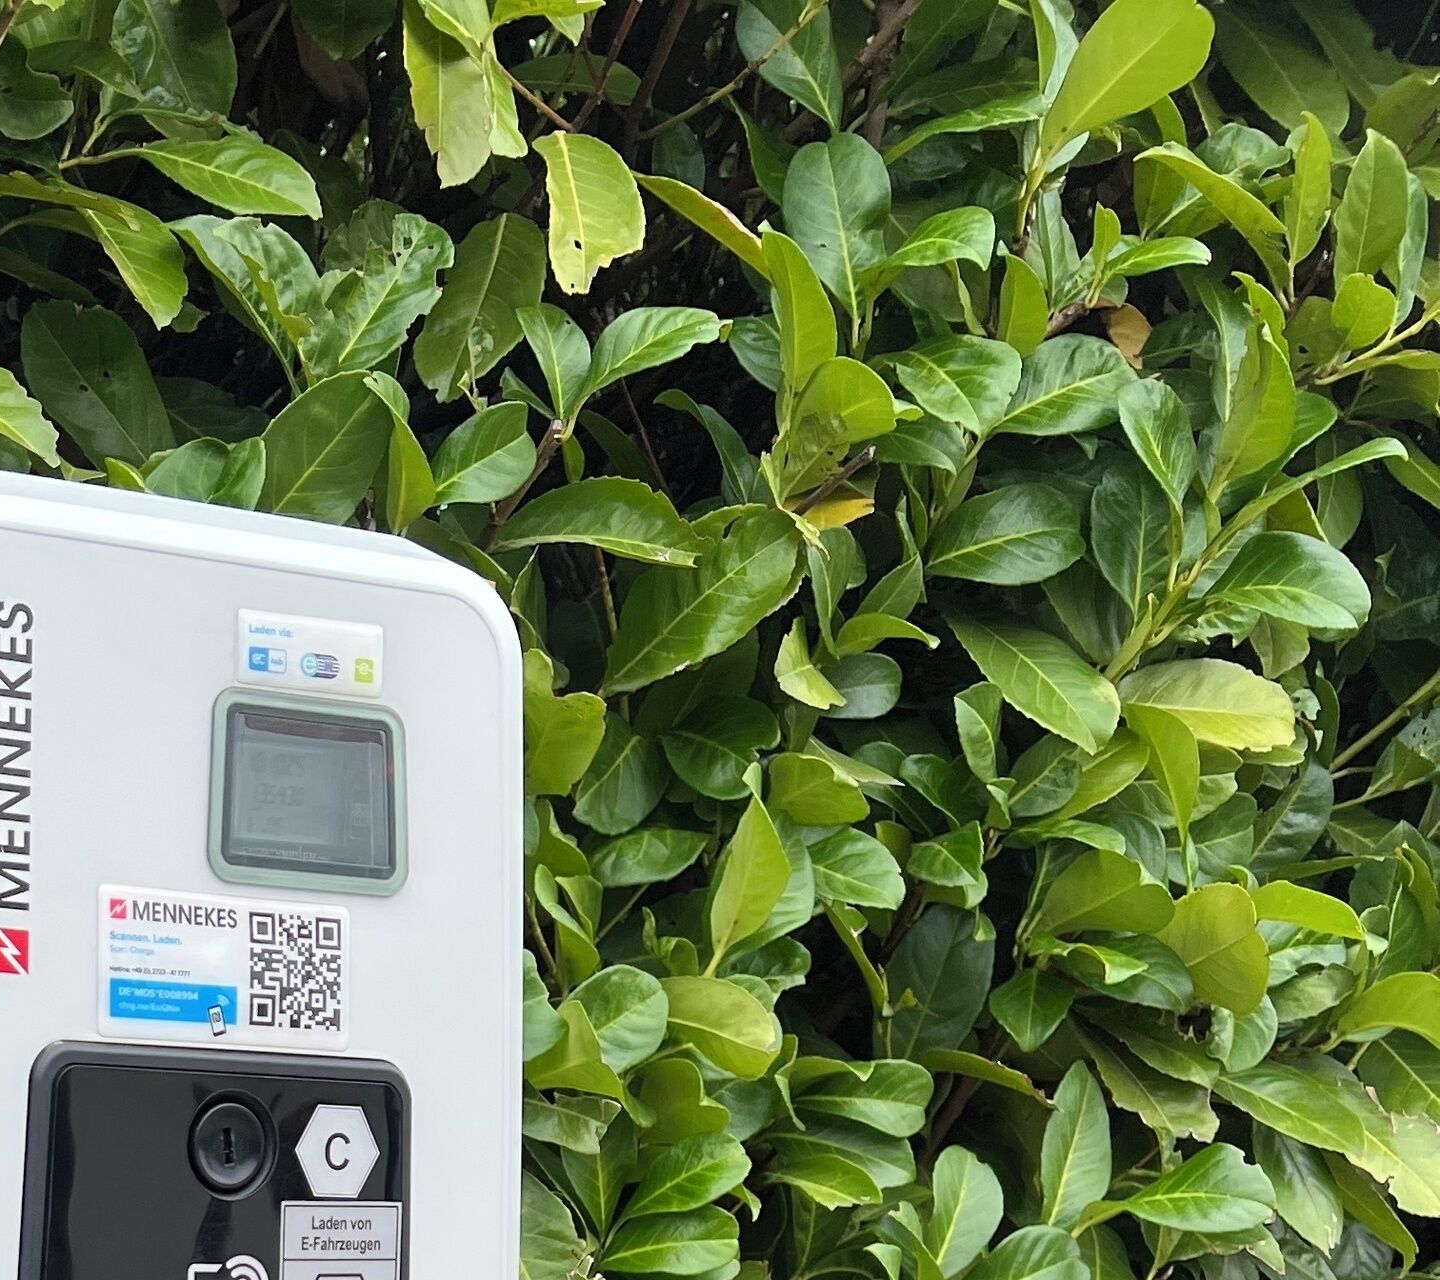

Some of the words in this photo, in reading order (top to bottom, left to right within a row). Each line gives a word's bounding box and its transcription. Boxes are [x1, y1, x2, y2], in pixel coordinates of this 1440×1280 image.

[248, 623, 277, 635] Laden
[132, 900, 238, 928] MENNEKES
[109, 930, 151, 943] Scannen.
[153, 934, 183, 945] Laden.
[324, 1132, 350, 1171] C
[311, 1215, 347, 1231] Laden
[350, 1219, 372, 1231] von
[301, 1236, 381, 1254] E-Fahrzeugen
